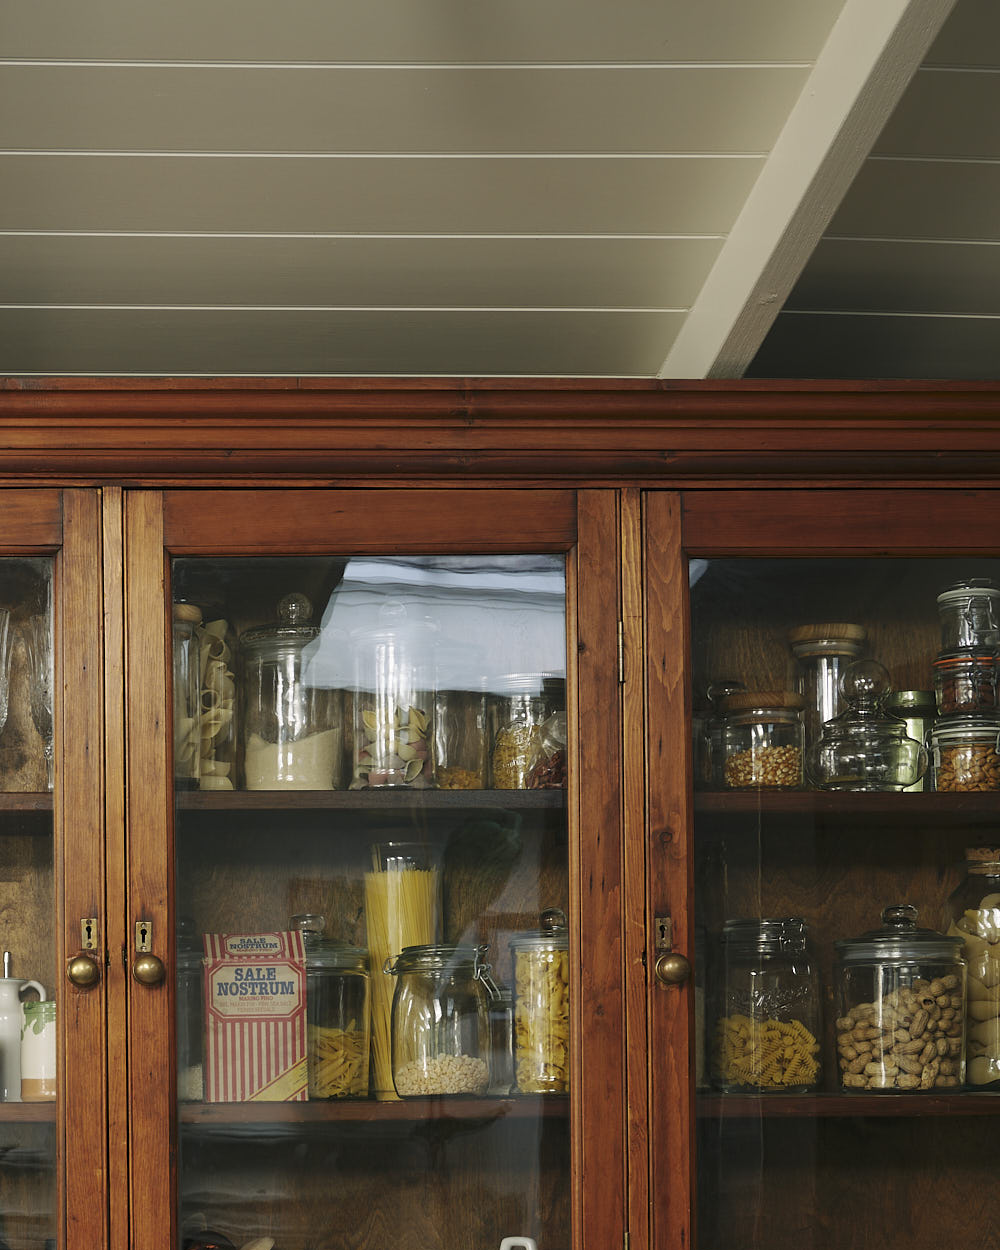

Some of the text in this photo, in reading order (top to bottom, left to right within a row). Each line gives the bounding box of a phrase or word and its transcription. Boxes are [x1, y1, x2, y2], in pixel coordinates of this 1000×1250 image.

[239, 937, 267, 945] SALE
[234, 967, 277, 982] SALE
[216, 981, 295, 996] NOSTRUM
